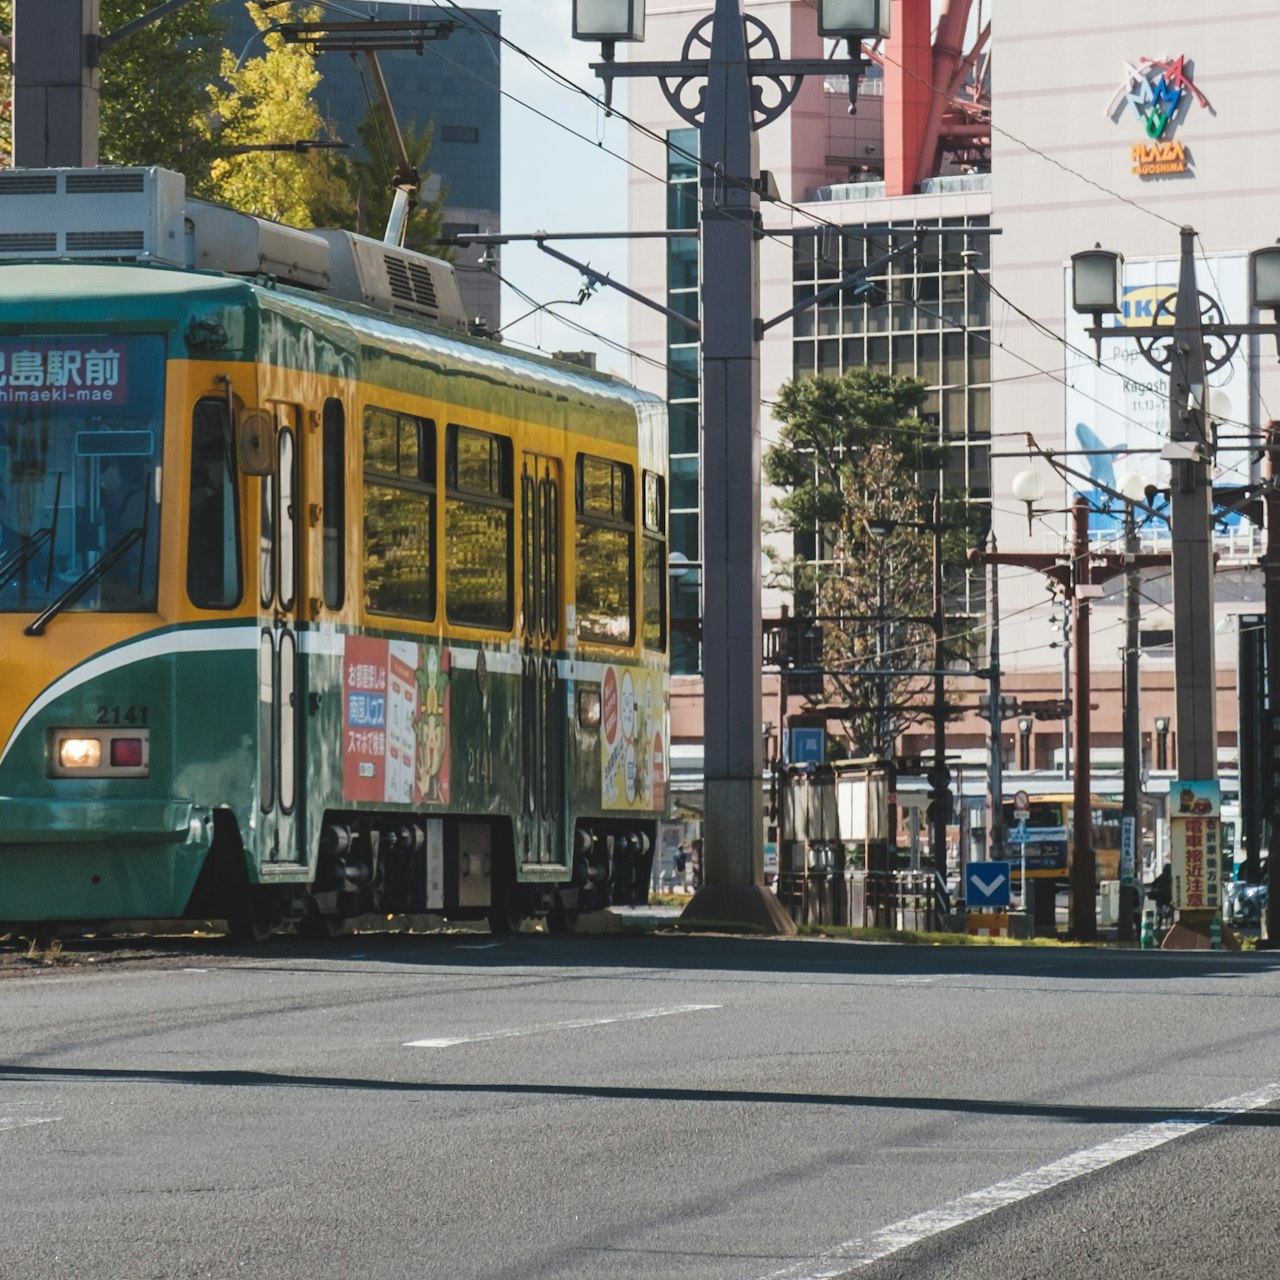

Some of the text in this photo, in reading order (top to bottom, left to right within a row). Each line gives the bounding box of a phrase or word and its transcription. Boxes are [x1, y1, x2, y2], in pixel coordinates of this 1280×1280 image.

[1131, 140, 1185, 162] PLAZA
[1131, 162, 1185, 174] KAGOSHIMA
[96, 705, 148, 724] 2141
[468, 749, 493, 784] 2141
